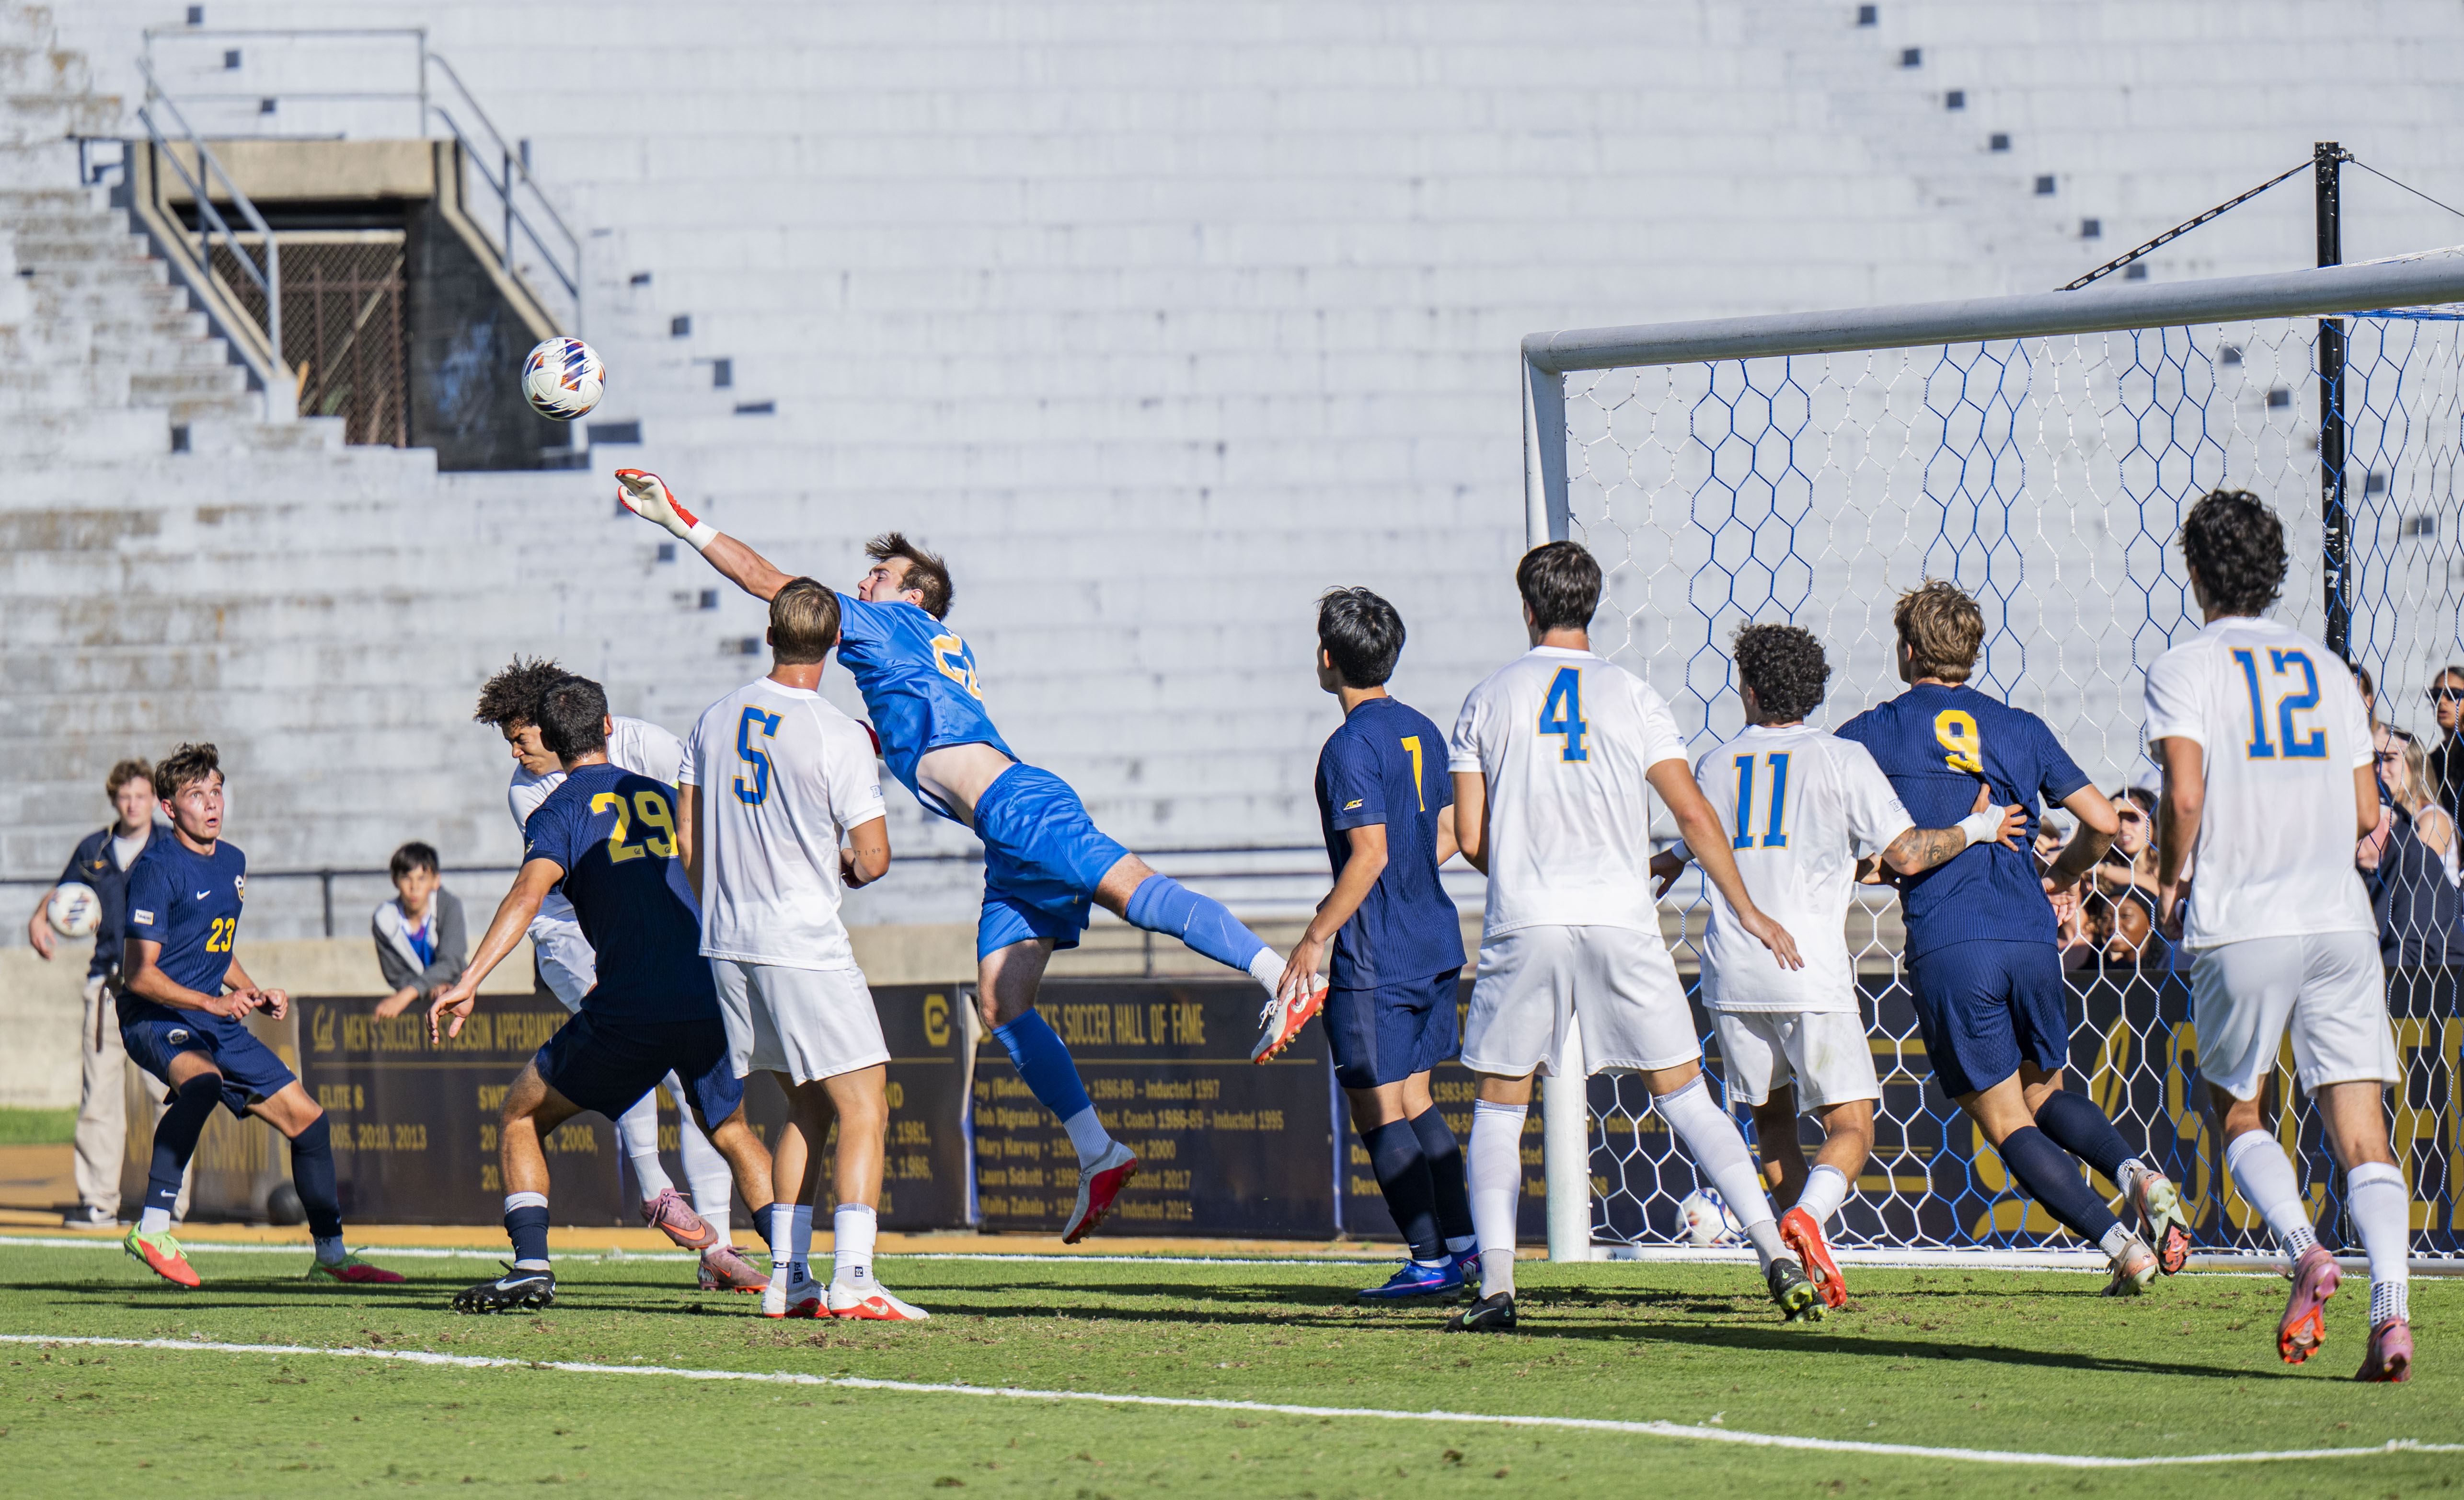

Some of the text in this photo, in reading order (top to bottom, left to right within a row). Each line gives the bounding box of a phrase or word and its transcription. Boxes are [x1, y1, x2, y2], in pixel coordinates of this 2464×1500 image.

[1537, 665, 1590, 764] 4
[2229, 646, 2330, 761] 12
[732, 704, 785, 807] 5
[1934, 710, 1984, 773] 9
[1732, 750, 1793, 851] 11
[590, 790, 678, 863] 29
[206, 918, 235, 952] 23
[380, 1013, 421, 1051] SOCCER
[1063, 1004, 1111, 1045] SOCCER
[1114, 1004, 1146, 1045] HALL
[1150, 1004, 1167, 1045] OF
[1171, 1004, 1206, 1045] FAME
[318, 1084, 352, 1111] ELITE
[1145, 1079, 1192, 1100] Inducted
[1212, 1109, 1256, 1130] Inducted
[1120, 1199, 1164, 1220] Inducted
